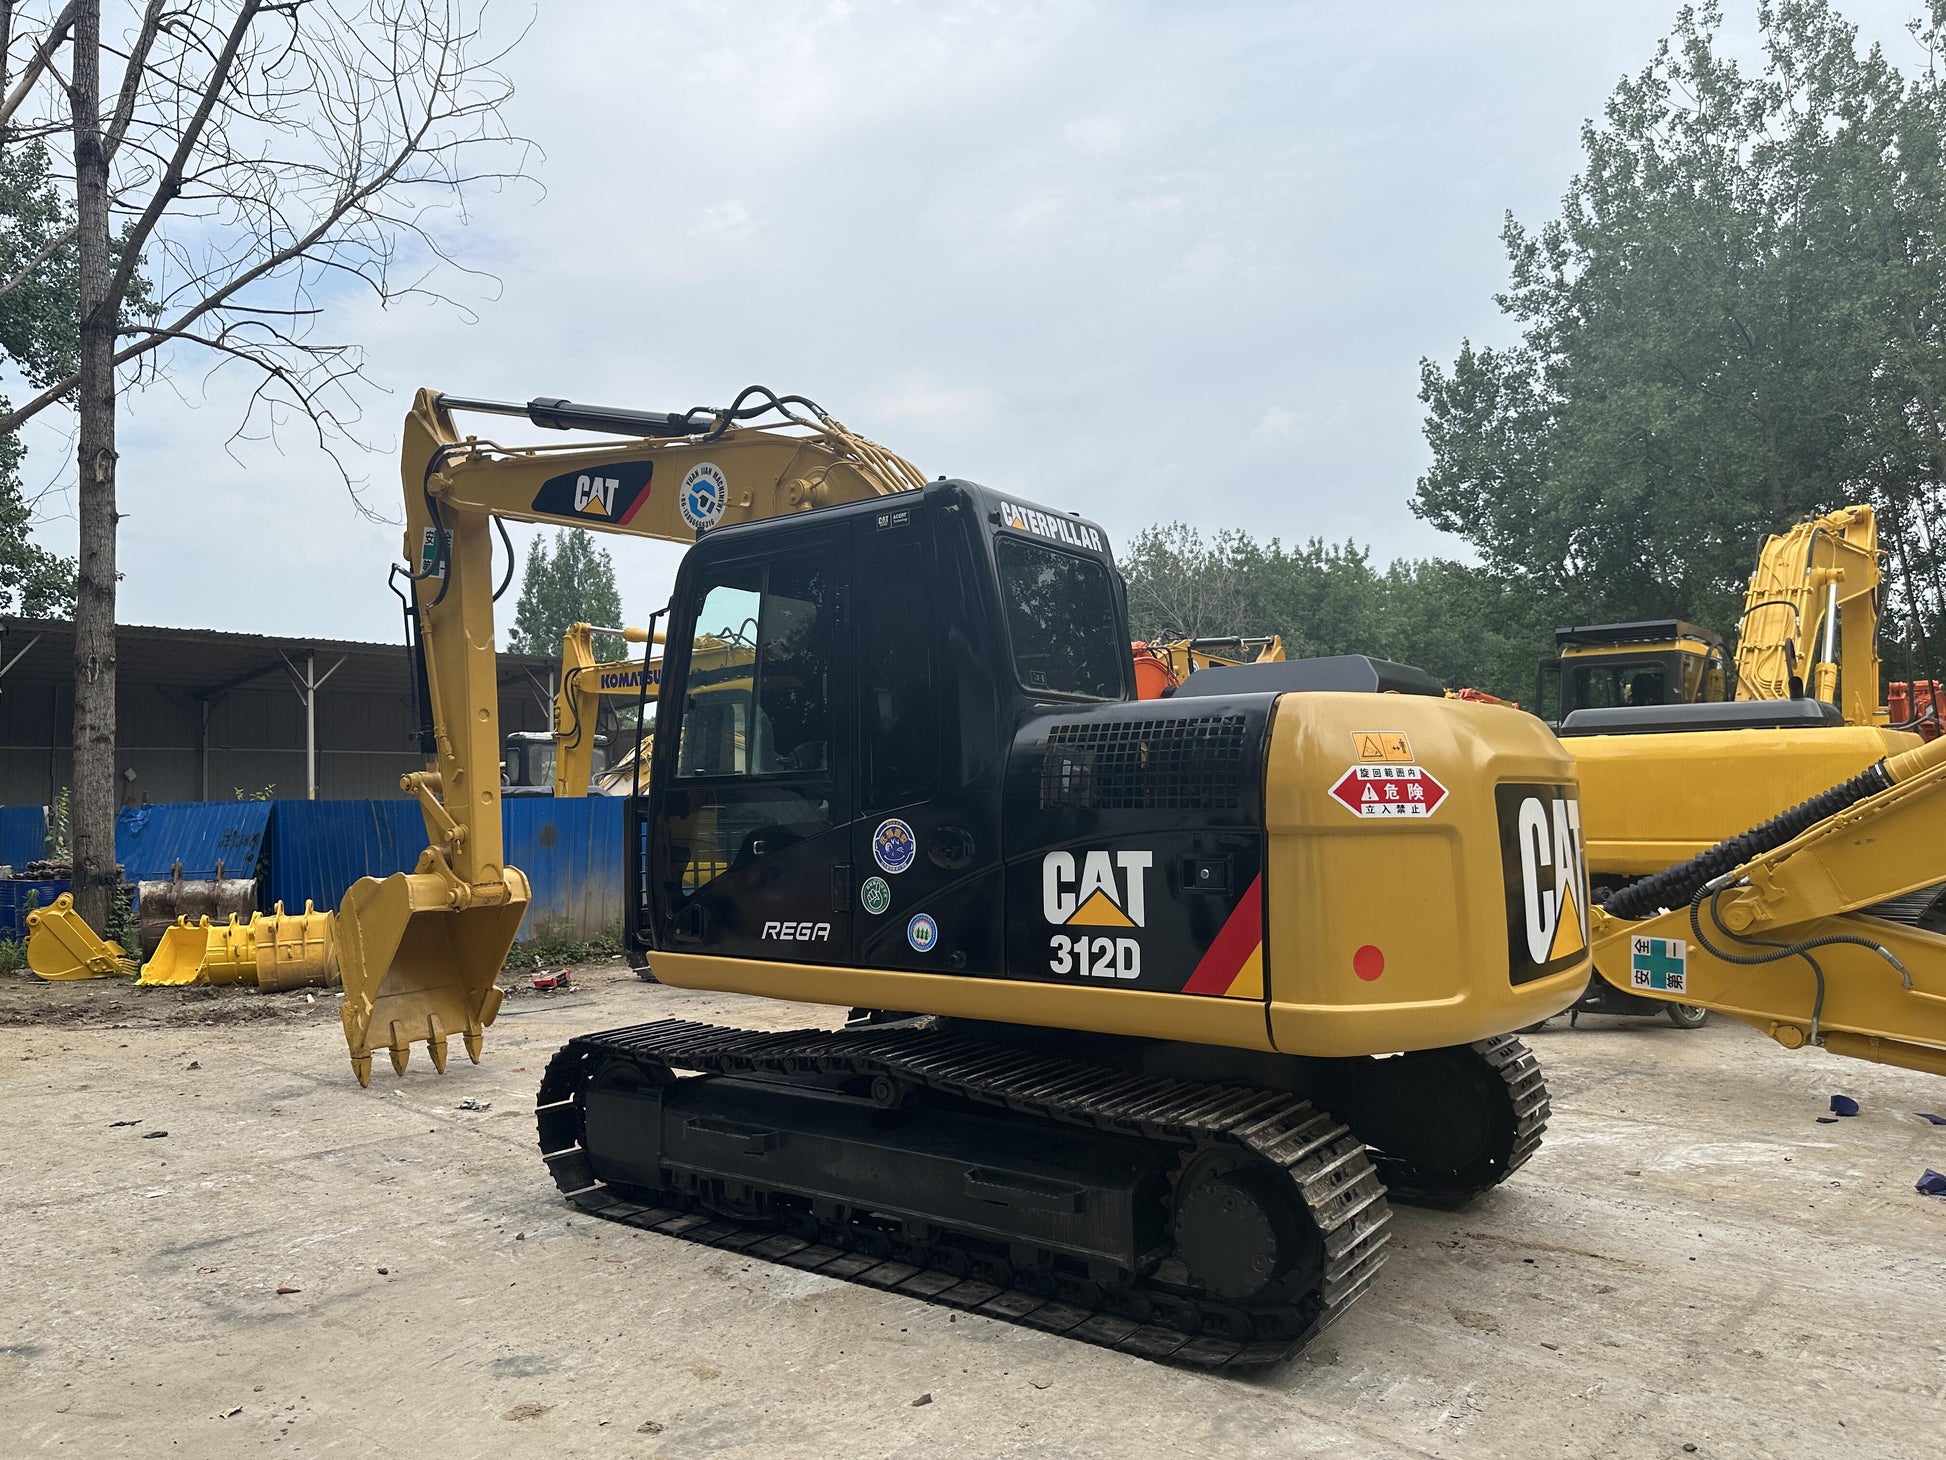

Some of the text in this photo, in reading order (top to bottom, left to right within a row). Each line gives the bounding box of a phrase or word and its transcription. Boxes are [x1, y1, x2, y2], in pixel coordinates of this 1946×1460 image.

[574, 475, 619, 516] CAT
[686, 469, 700, 486] YUAN
[712, 471, 725, 514] MACHINERY
[878, 515, 889, 525] CAT
[1000, 501, 1103, 552] CATERPILLAR
[601, 669, 661, 689] KOMATSU
[1365, 804, 1420, 814] 立入禁止
[1384, 783, 1424, 800] 危険
[1043, 851, 1152, 927] CAT
[1519, 798, 1587, 964] CAT
[761, 921, 831, 941] REGA
[1050, 934, 1140, 979] 312D
